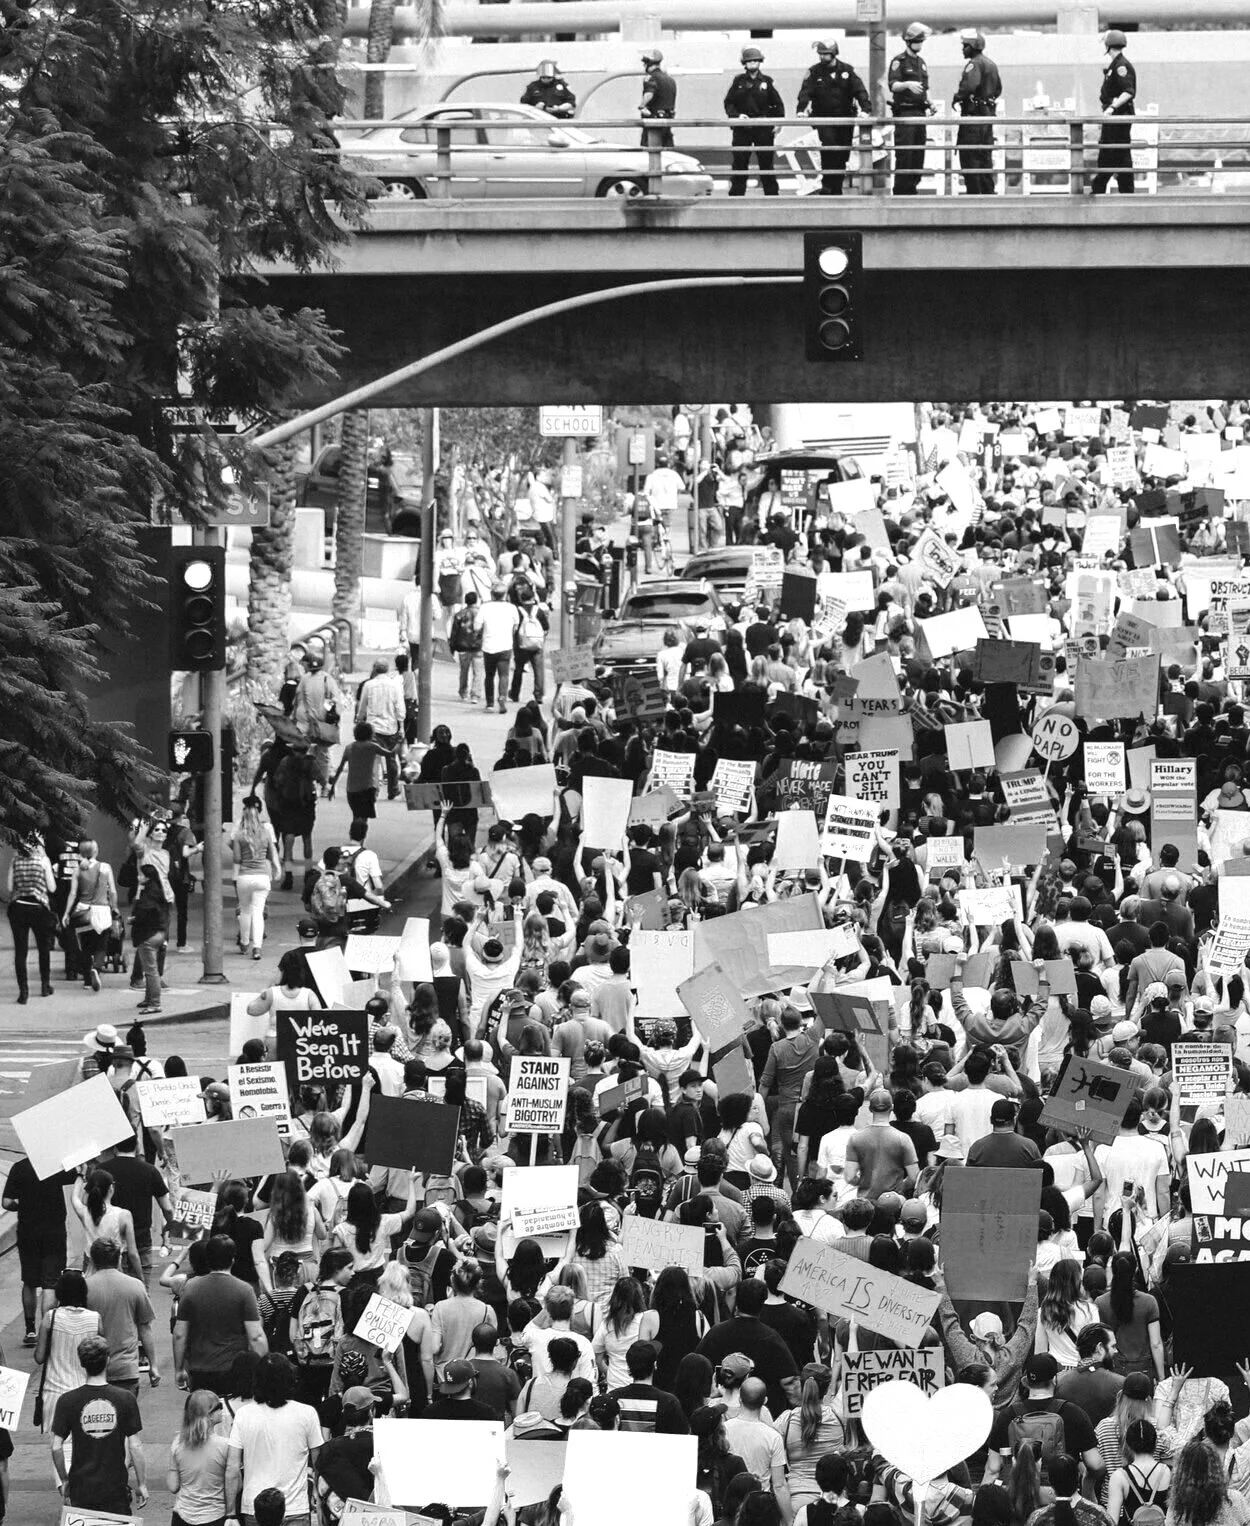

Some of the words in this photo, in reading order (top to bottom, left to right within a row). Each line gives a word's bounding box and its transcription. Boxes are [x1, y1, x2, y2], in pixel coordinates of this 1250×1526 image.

[545, 418, 598, 432] SCHOOL
[844, 699, 853, 711] 4
[861, 699, 898, 711] YEARS
[1043, 719, 1072, 738] NO
[1034, 734, 1069, 760] DAPL
[845, 752, 868, 761] DEAR
[871, 750, 899, 760] TRUMP
[791, 760, 822, 780] Hate
[858, 760, 885, 771] YOU
[1153, 765, 1193, 775] Hillary
[852, 770, 890, 782] CAN'T
[1006, 777, 1036, 789] TRUMP
[776, 777, 806, 796] NEVER
[808, 781, 833, 792] MADE
[862, 781, 884, 792] SIT
[856, 791, 888, 801] WITH
[289, 1016, 339, 1038] We've
[296, 1037, 340, 1056] Seen
[340, 1033, 361, 1056] It
[247, 1064, 273, 1073] Resistir
[297, 1055, 362, 1081] Before
[521, 1061, 560, 1075] STAND
[1179, 1064, 1226, 1072] NEGAMOS
[516, 1077, 561, 1091] AGAINST
[260, 1102, 281, 1111] Guerra
[511, 1098, 563, 1109] ANTI-MUSLIM
[513, 1110, 558, 1122] BIGOTRY!
[1194, 1157, 1250, 1179] WAIT
[175, 1199, 216, 1217] DONALD
[629, 1217, 685, 1242] ANGRY
[626, 1239, 703, 1264] FEMINIST
[793, 1259, 848, 1292] AMERICA
[845, 1276, 874, 1309] IS
[878, 1295, 932, 1328] DIVERSITY
[367, 1327, 387, 1345] GO
[844, 1351, 873, 1371] WE
[874, 1350, 934, 1371] WANT
[82, 1412, 115, 1425] CAGEFEST
